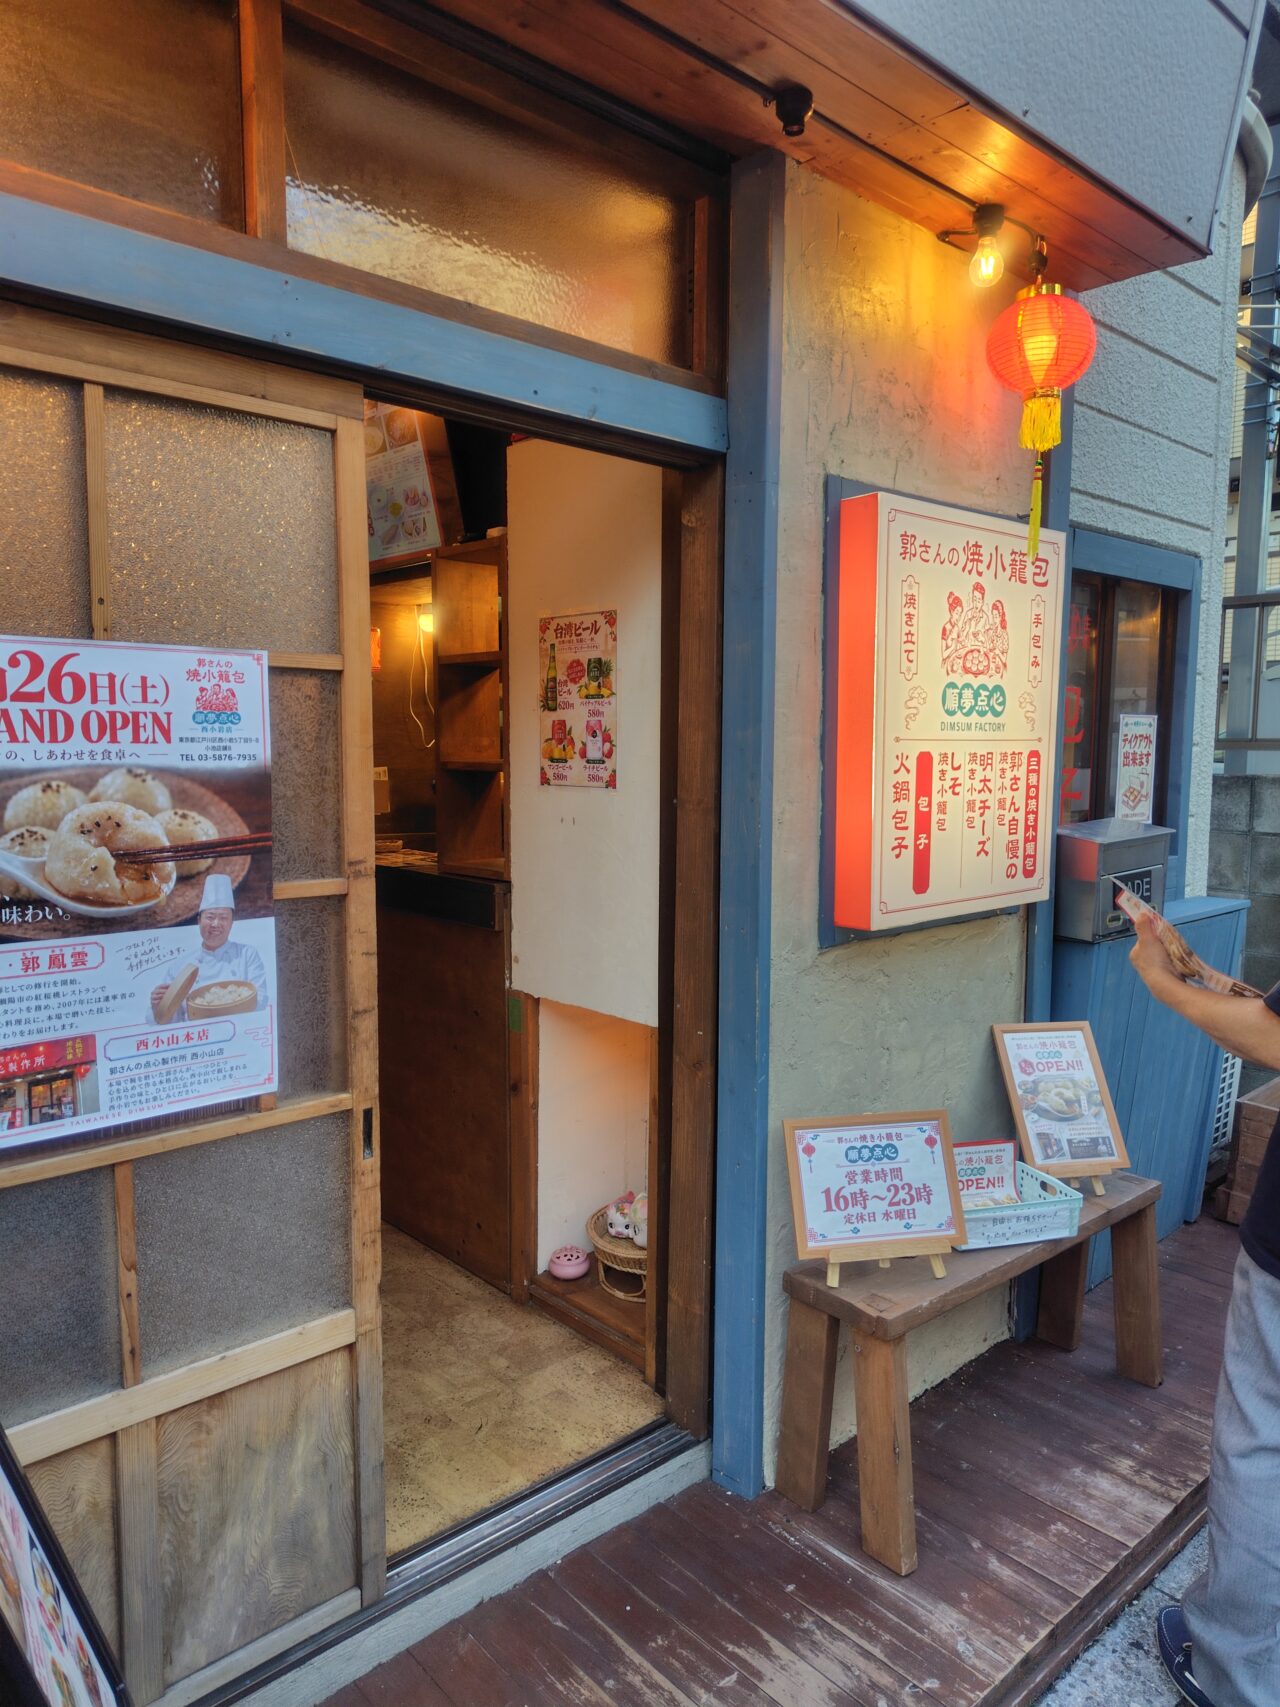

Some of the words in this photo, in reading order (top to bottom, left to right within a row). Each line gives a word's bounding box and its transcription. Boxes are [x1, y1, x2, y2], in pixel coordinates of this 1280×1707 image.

[899, 530, 1049, 588] 郭さんの焼小籠包
[554, 619, 601, 639] 台湾ビール
[903, 592, 917, 664] 焼き立て
[1030, 612, 1043, 668] 手包み
[186, 668, 246, 684] 焼小籠包
[197, 657, 233, 668] 郭さんの
[0, 650, 170, 707] 26日(土)
[944, 686, 1005, 713] 順夢点心
[81, 710, 173, 744] OPEN
[940, 722, 972, 732] DIMSUM
[974, 722, 1006, 732] FACTORY
[0, 748, 141, 762] の、しあわせを食卓へ
[1122, 733, 1152, 750] テイクアウト
[180, 753, 195, 762] TEL
[198, 753, 257, 762] 03-5876-7935
[1122, 750, 1151, 768] 出来ます
[949, 752, 962, 796] しそ
[936, 752, 949, 832] 焼き小籠包
[965, 752, 978, 829] 焼き小籠包
[996, 752, 1008, 826] 焼き小籠包
[891, 752, 910, 859] 火鍋包子
[976, 752, 993, 857] 明太チーズ
[1005, 751, 1023, 879] 郭さん自慢の
[1025, 757, 1038, 870] 三種の焼き小籠包
[916, 796, 930, 850] 包子
[1127, 877, 1151, 897] ADE
[1, 905, 72, 925] 味わい。
[136, 1028, 209, 1052] 西小山本店
[109, 1053, 187, 1076] 郭さんの点心製作所
[190, 1047, 225, 1061] 西小山店
[70, 1111, 123, 1127] TAIWANESE
[128, 1102, 164, 1116] DIMSUM
[847, 1145, 897, 1162] 順夢点心
[845, 1167, 904, 1185] 営業時間
[843, 1211, 877, 1225] 定休日
[881, 1208, 917, 1221] 水曜日
